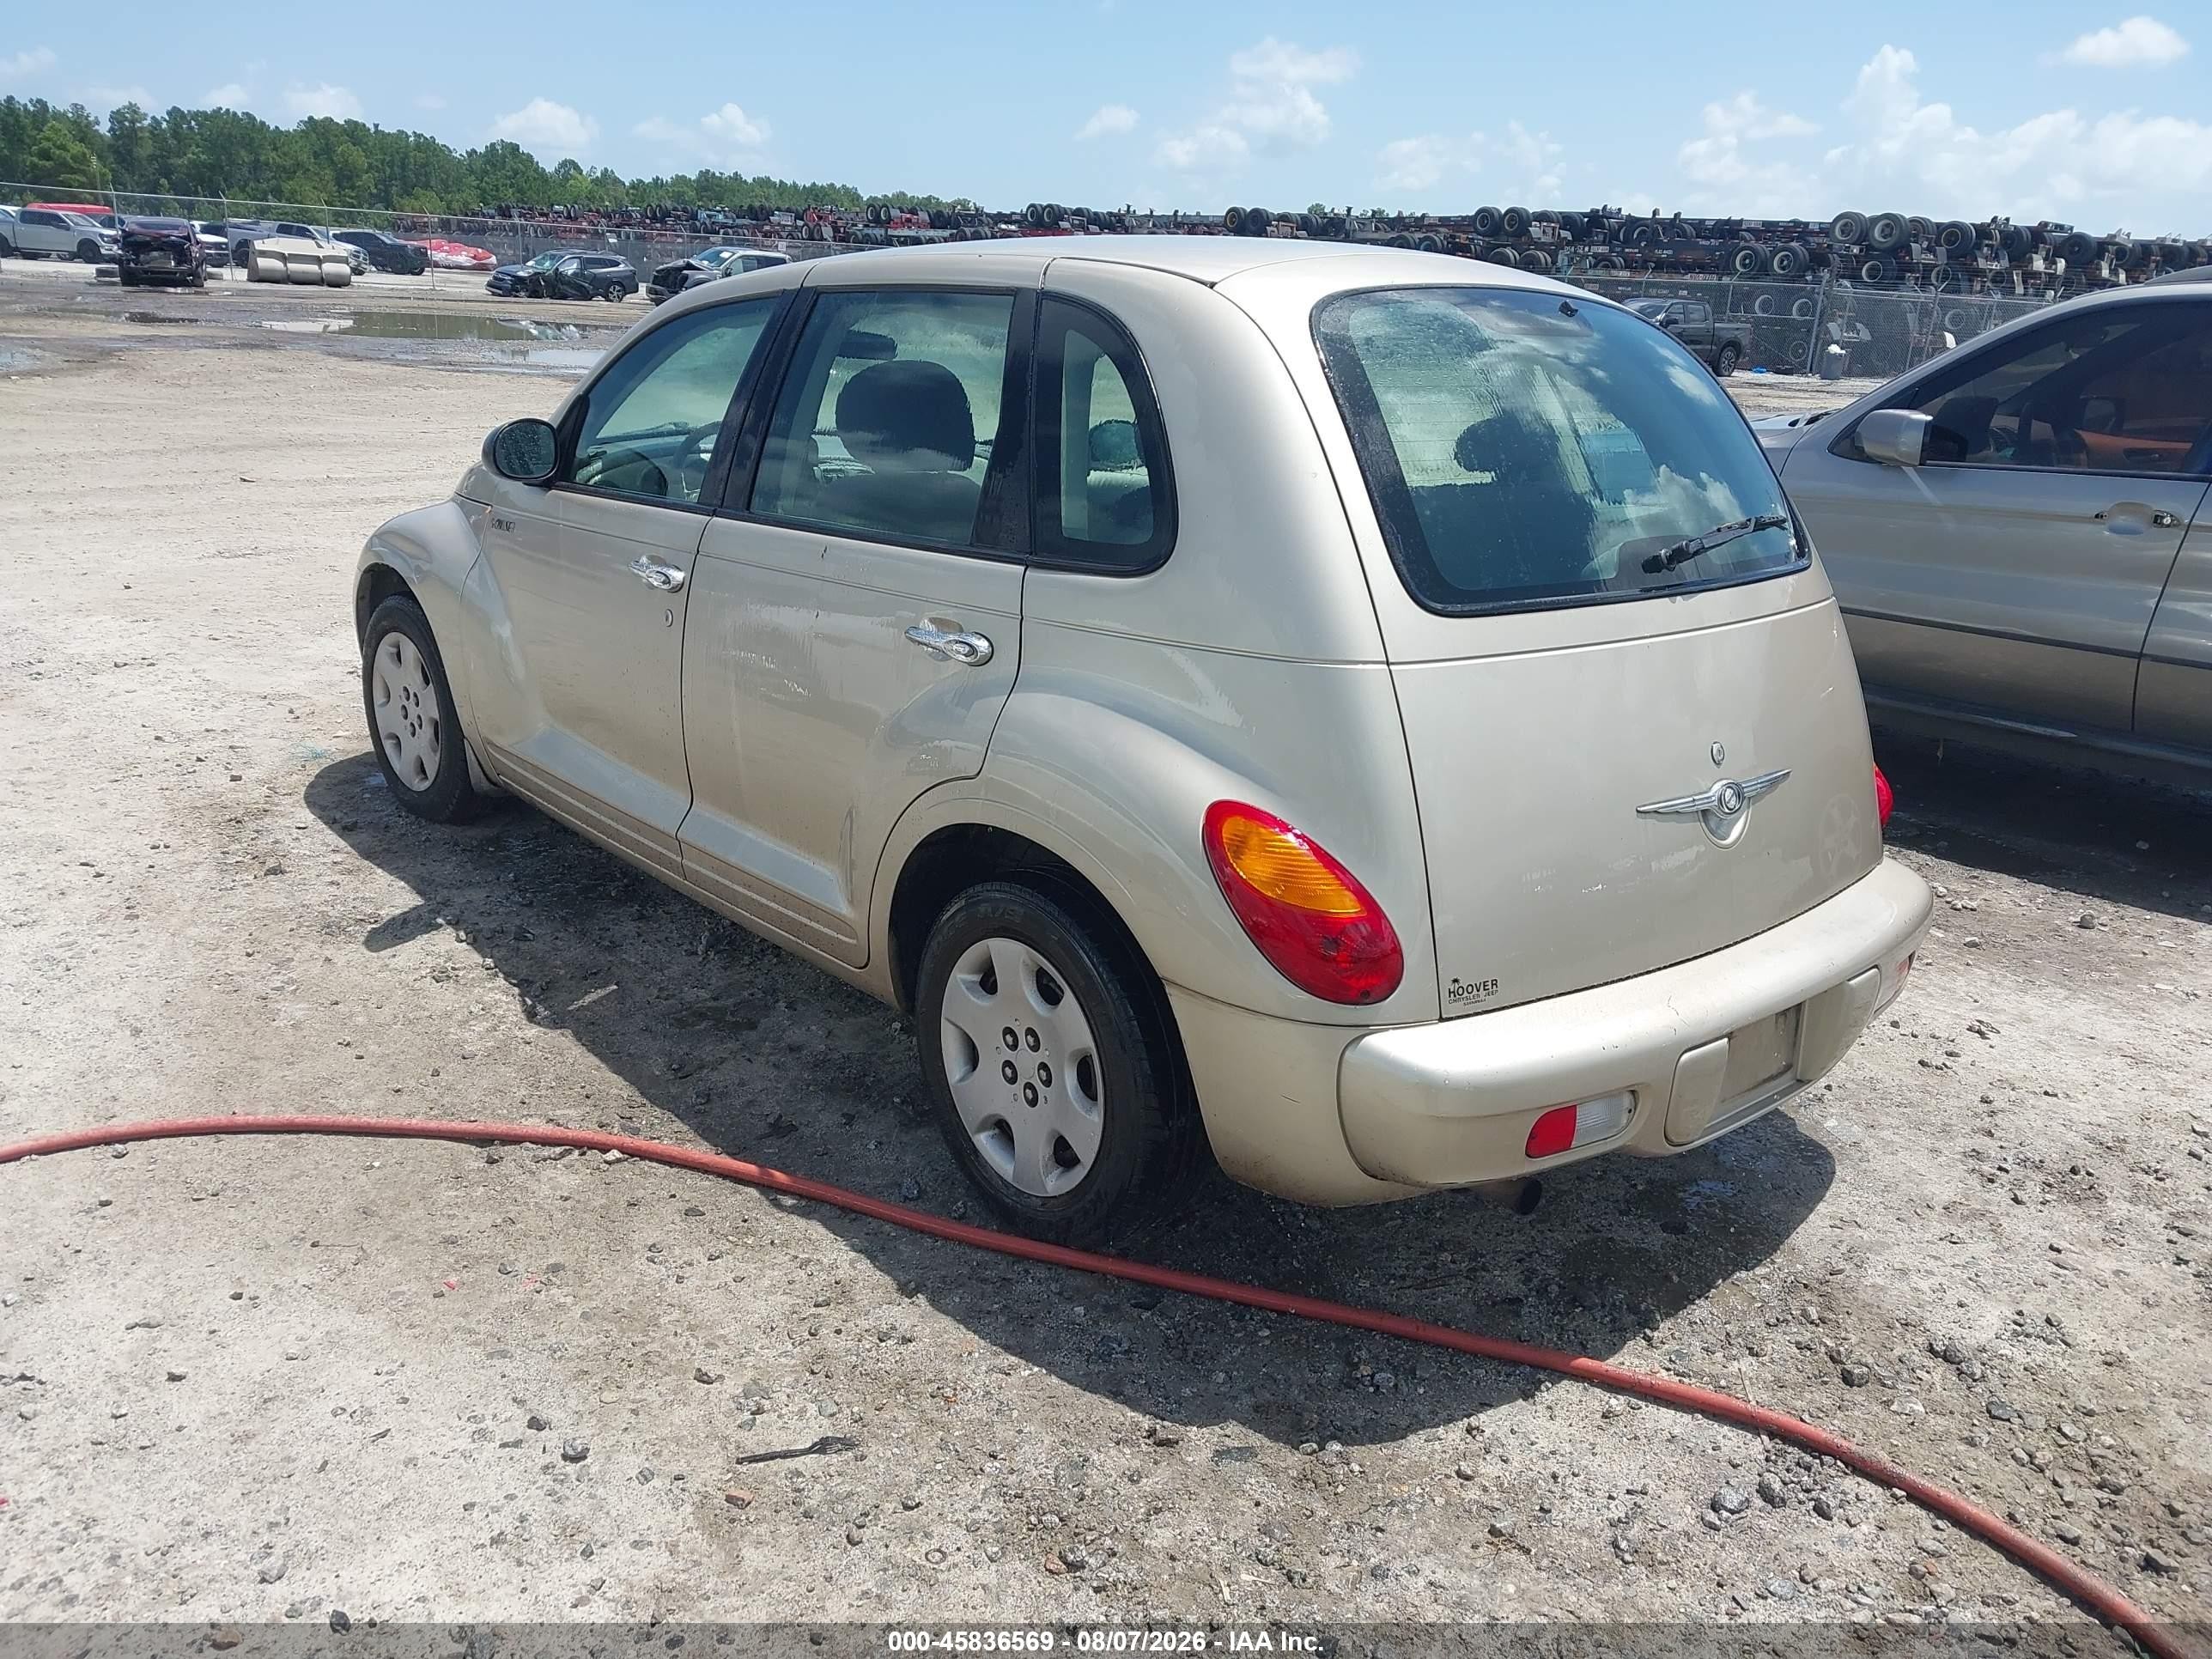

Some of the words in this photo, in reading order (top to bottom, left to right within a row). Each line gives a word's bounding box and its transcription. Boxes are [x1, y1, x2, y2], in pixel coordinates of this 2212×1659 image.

[1448, 978, 1498, 998] HOOVER
[1448, 994, 1480, 1005] CHRYSLER
[1483, 989, 1498, 998] JEEP
